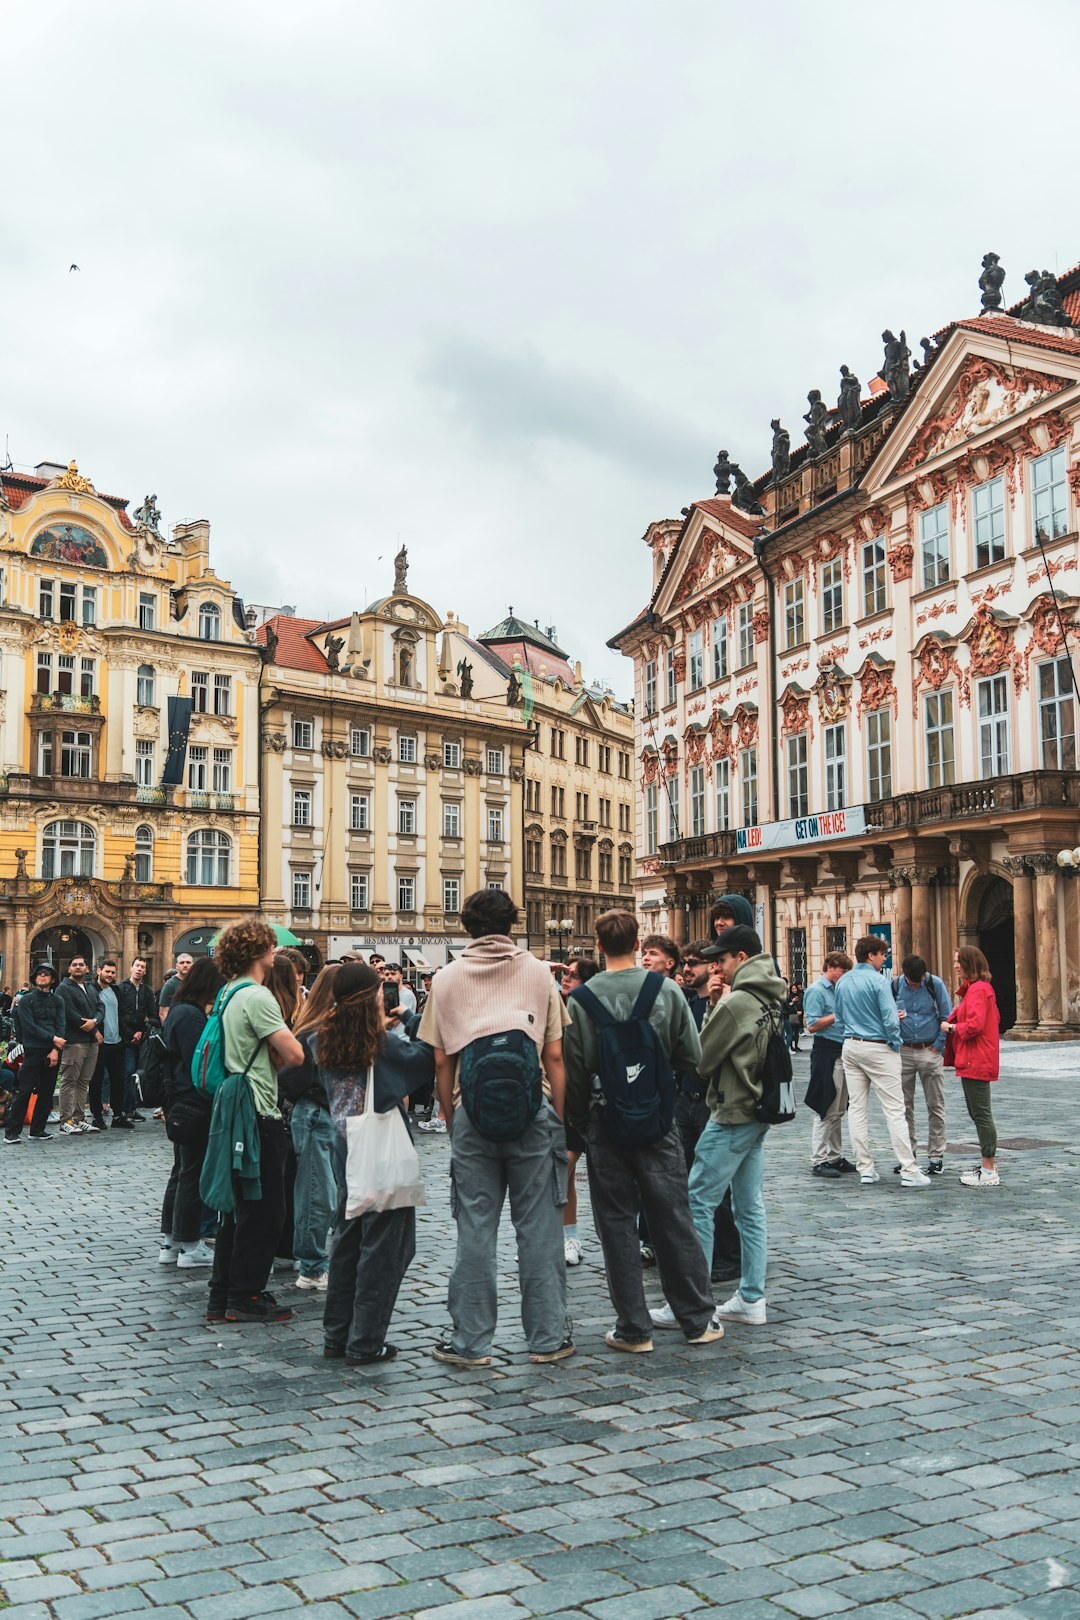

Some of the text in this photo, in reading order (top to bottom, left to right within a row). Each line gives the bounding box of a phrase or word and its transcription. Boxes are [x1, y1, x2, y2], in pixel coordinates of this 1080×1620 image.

[795, 820, 808, 840] GET
[808, 818, 818, 837] ON
[818, 815, 832, 836] THE
[832, 812, 846, 833] ICE!
[738, 827, 762, 848] NA LED!
[364, 936, 453, 945] RESTAURACE MINCOVNA
